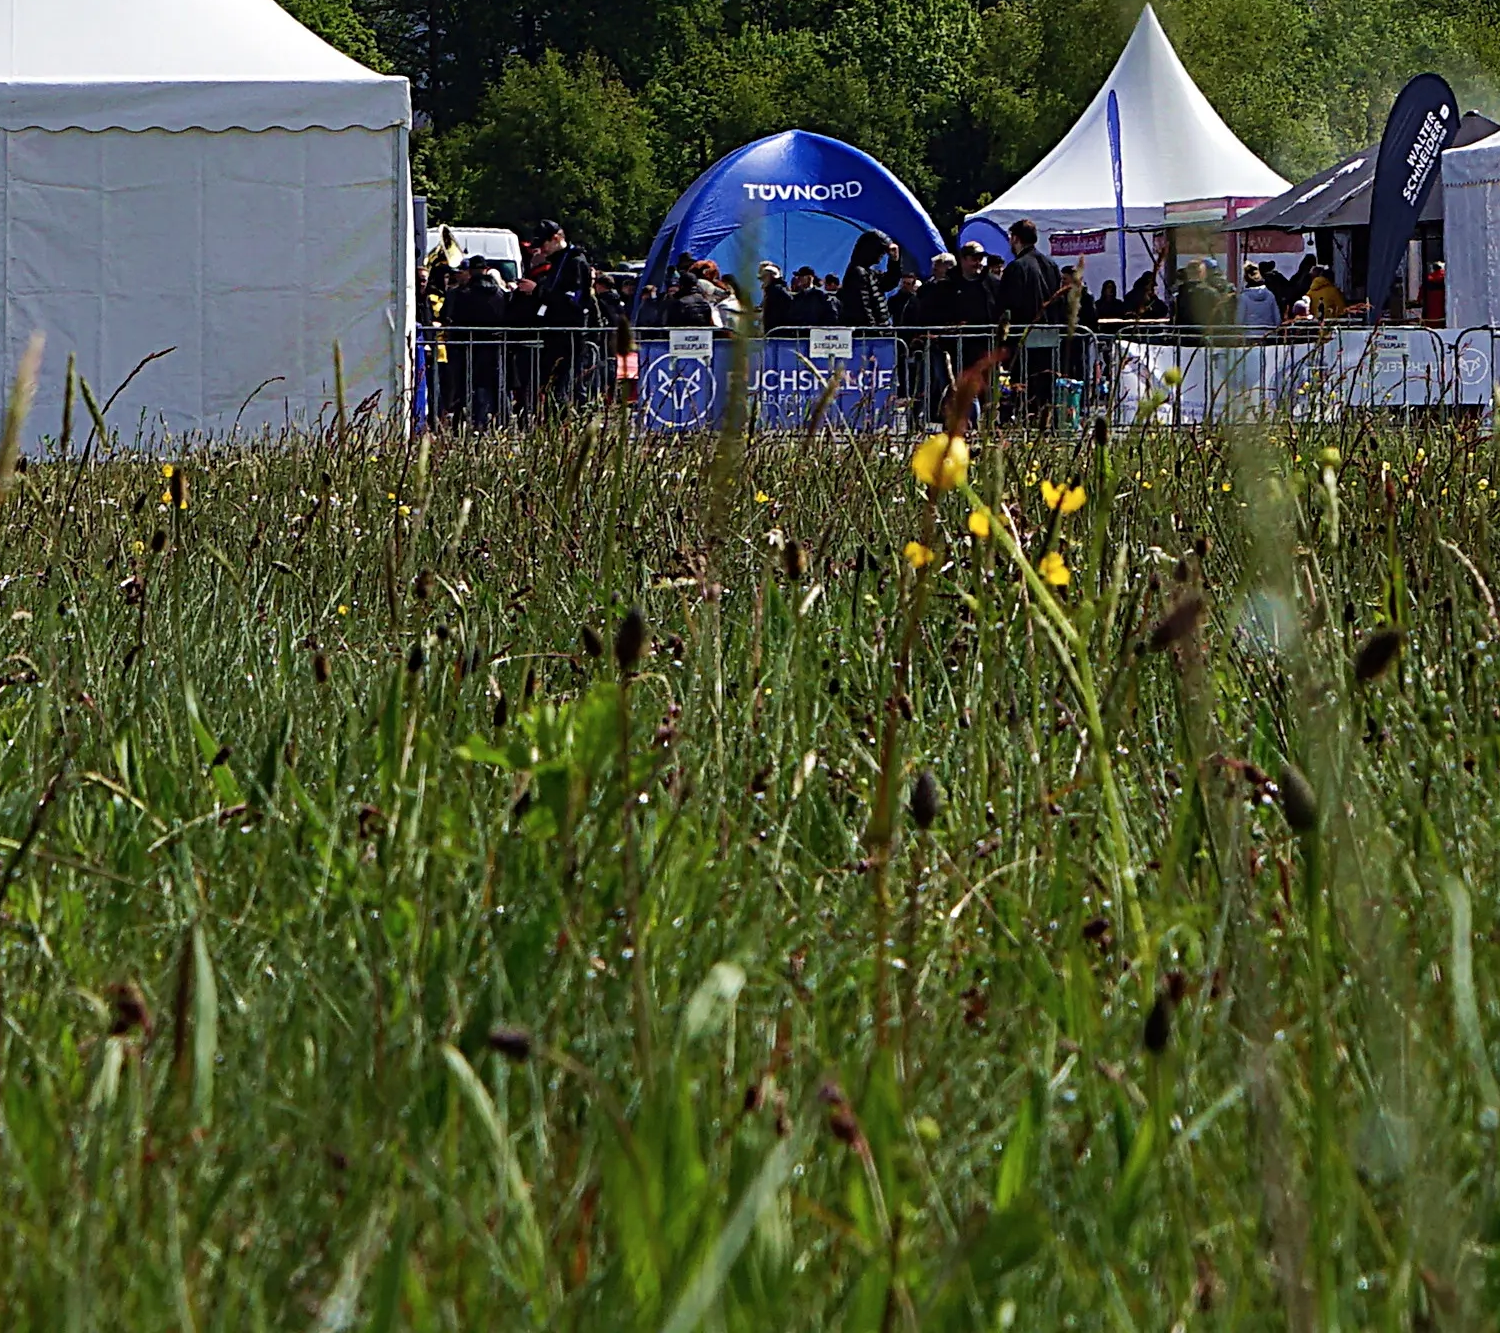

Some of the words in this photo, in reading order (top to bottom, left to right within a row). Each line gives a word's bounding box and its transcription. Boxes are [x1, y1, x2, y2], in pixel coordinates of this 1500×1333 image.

[1402, 120, 1444, 201] SCHNEIDER
[1406, 111, 1437, 167] WALTER
[742, 180, 863, 201] TÜVNORD
